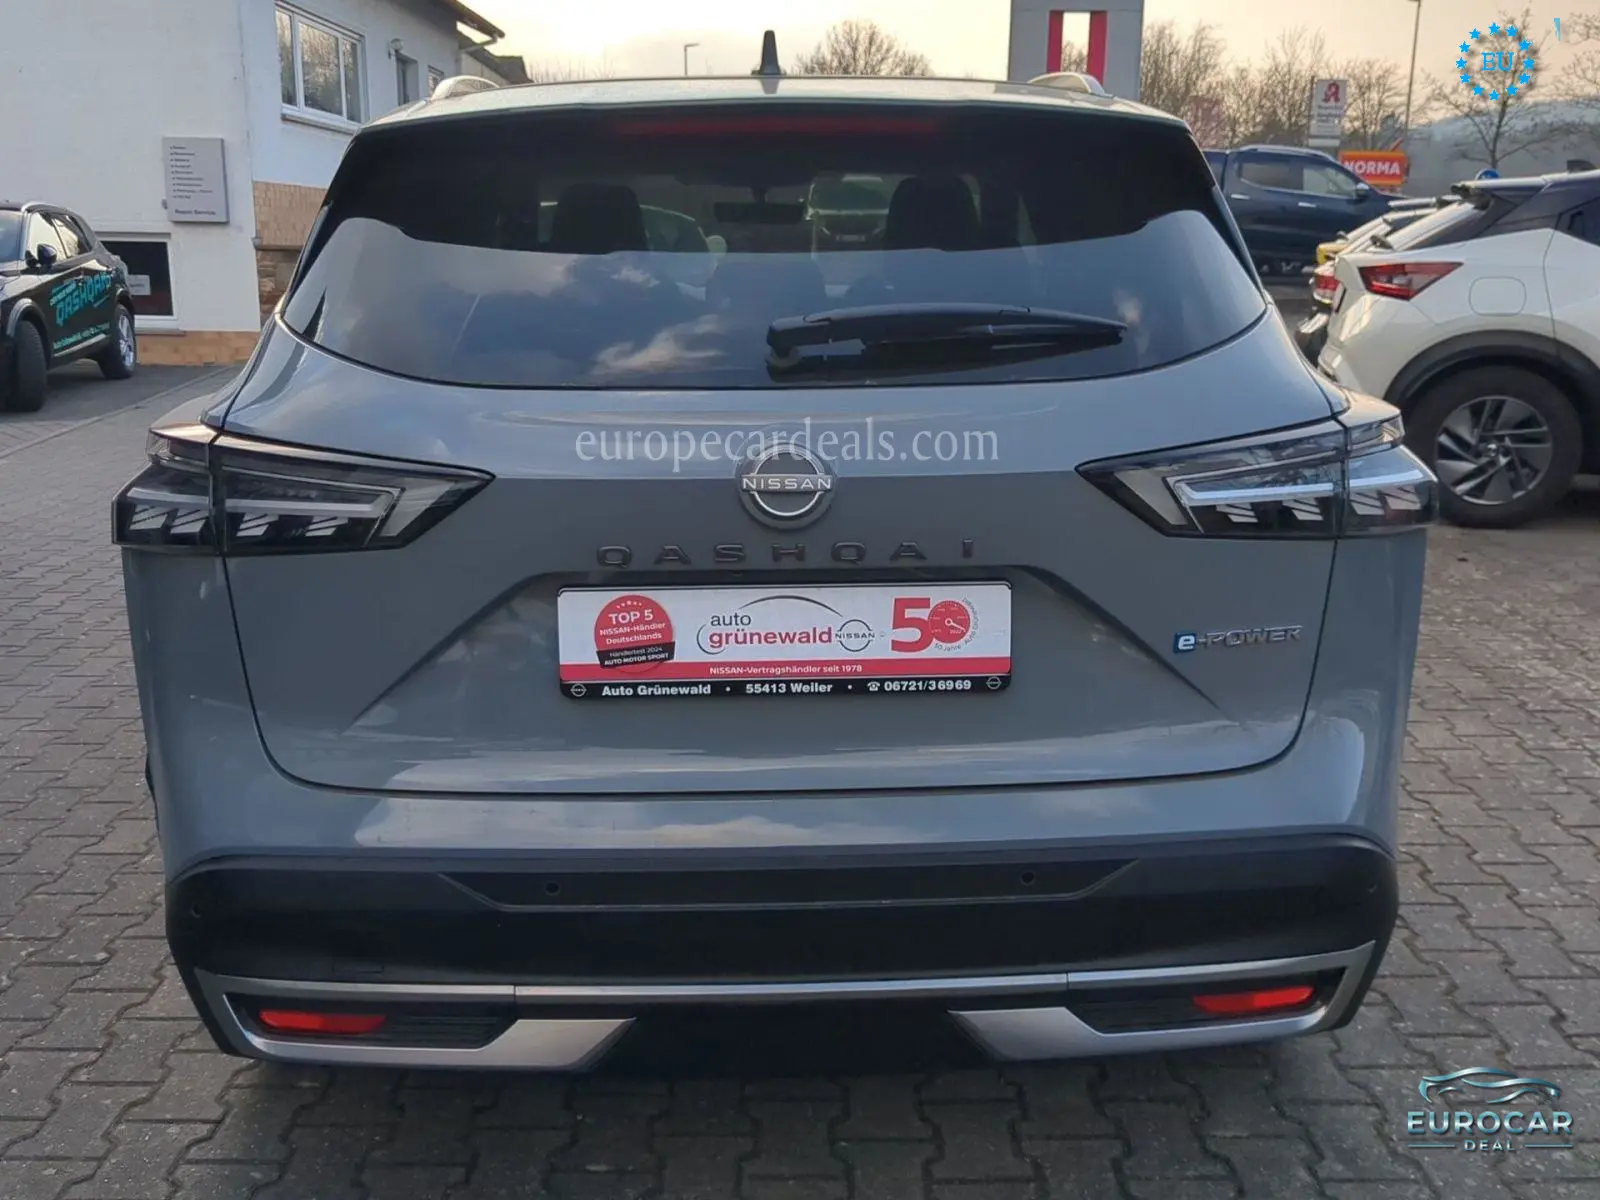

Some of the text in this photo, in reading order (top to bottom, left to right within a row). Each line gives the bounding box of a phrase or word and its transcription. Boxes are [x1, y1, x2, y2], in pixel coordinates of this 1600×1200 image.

[1343, 160, 1401, 176] NORMA
[742, 476, 832, 490] NISSAN
[596, 537, 976, 569] QASHQAI
[608, 609, 654, 625] TOP 5
[710, 612, 752, 627] auto
[600, 622, 666, 637] NISSAN-Händler
[835, 632, 875, 640] NISSAN
[606, 633, 663, 645] Deutschlands
[708, 627, 832, 649] grünewald
[604, 652, 669, 666] AUTO MOTOR SPORT
[709, 664, 862, 676] NISSAN-Vertragshändler seit 1978
[601, 685, 633, 697] Auto
[637, 684, 711, 696] Grünewald
[745, 683, 786, 694] 55413
[791, 682, 833, 693] Weiler
[884, 680, 972, 692] 06721/36969
